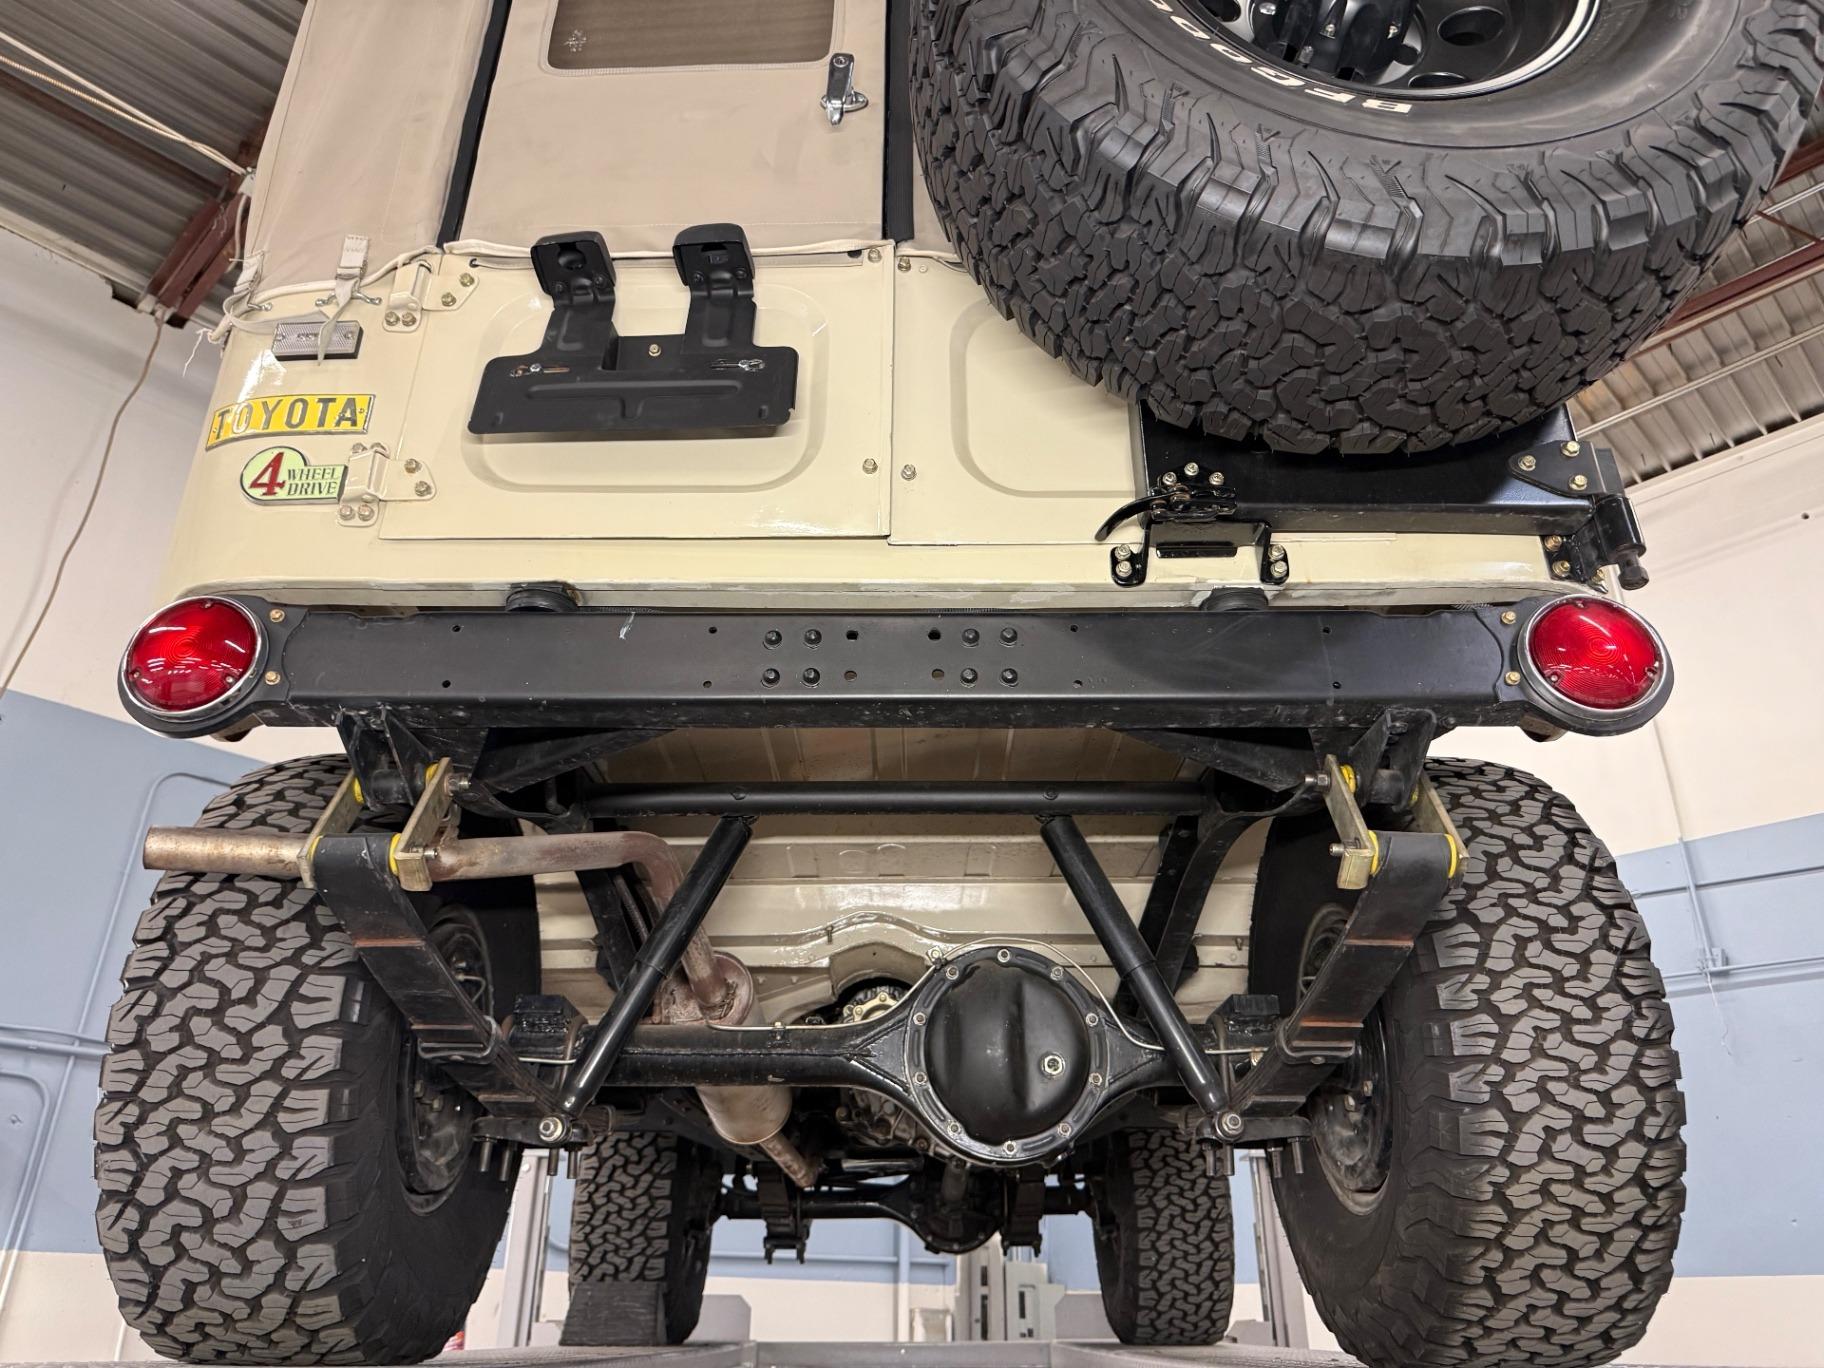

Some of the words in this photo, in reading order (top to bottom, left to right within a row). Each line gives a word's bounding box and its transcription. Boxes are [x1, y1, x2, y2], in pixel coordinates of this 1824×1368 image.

[214, 397, 358, 440] TOYOTA
[248, 451, 286, 496] 4
[287, 466, 340, 481] WHEEL
[287, 481, 337, 496] DRIVE
